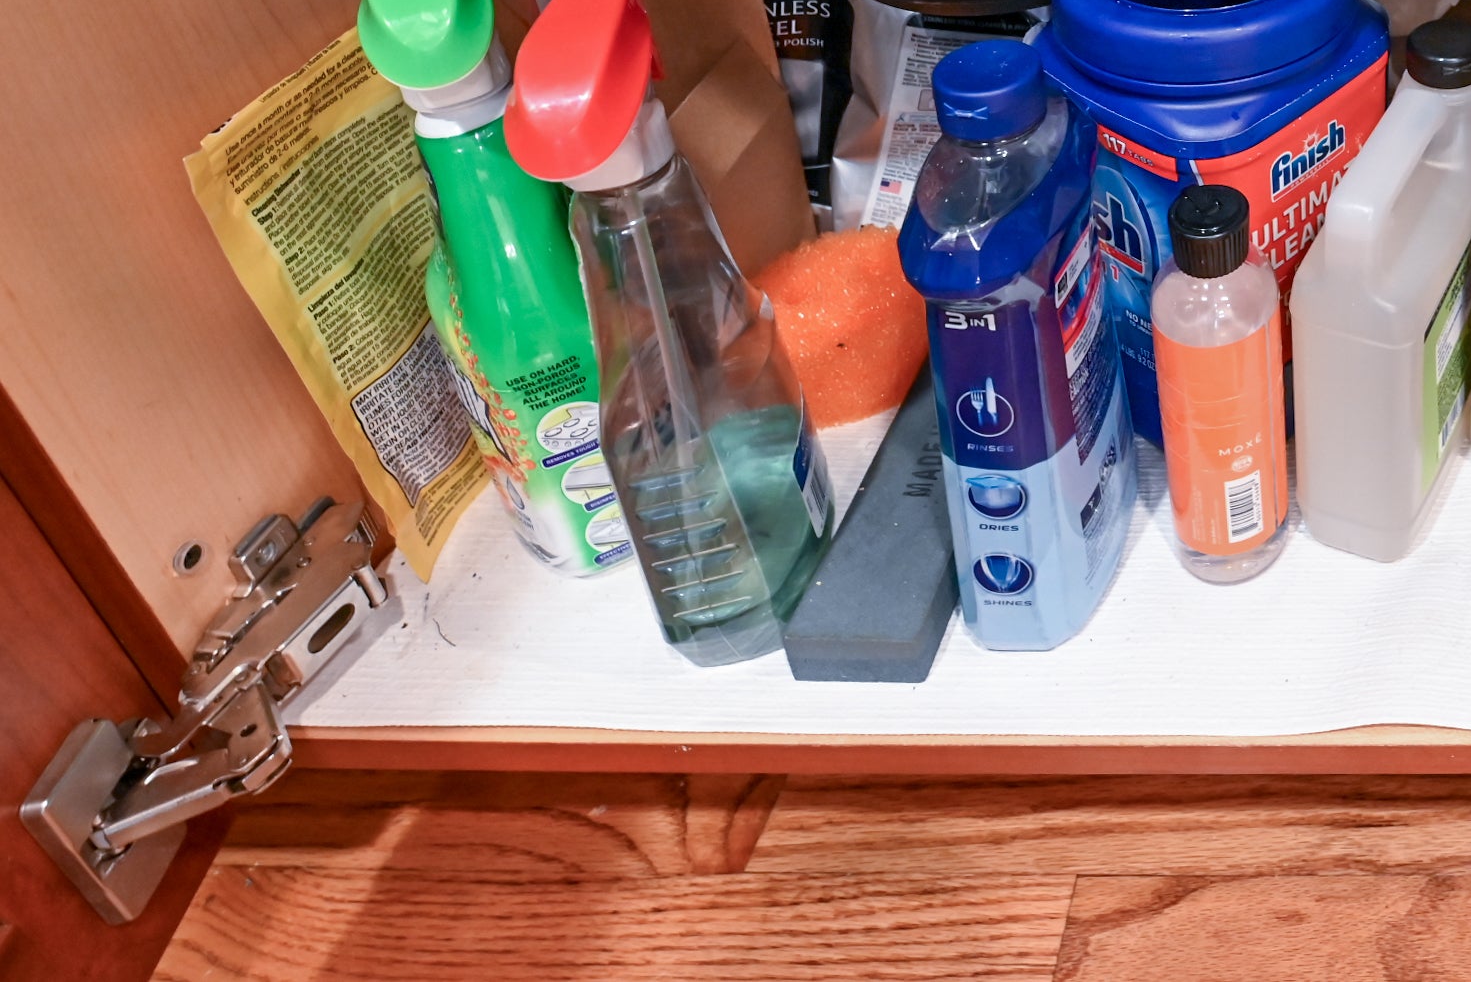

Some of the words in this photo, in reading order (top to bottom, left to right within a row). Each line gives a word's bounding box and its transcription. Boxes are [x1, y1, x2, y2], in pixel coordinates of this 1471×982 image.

[783, 37, 825, 48] POLISH
[224, 141, 241, 155] Use
[239, 127, 257, 144] once
[261, 104, 284, 125] month
[284, 98, 293, 107] or
[292, 92, 302, 101] as
[301, 72, 327, 94] needed
[326, 65, 337, 75] for
[233, 151, 266, 180] triturador
[264, 143, 275, 154] de
[273, 125, 298, 146] basura
[1103, 133, 1126, 155] 117
[1271, 120, 1345, 195] finish
[233, 161, 269, 194] suministro
[268, 154, 278, 164] de
[277, 143, 289, 156] 2-6
[251, 194, 277, 217] Cleaning
[307, 287, 335, 313] Limpieza
[333, 279, 345, 291] del
[505, 375, 527, 387] USE
[529, 369, 545, 379] ON
[547, 354, 581, 373] HARD,
[512, 361, 581, 393] NON-POROUS
[523, 371, 578, 397] SURFACES
[354, 389, 374, 407] MAY
[373, 364, 405, 393] IRRITATE
[359, 385, 395, 415] IRRITATE
[364, 398, 391, 423] FUMES
[390, 380, 411, 401] FORM
[409, 362, 425, 382] WHEN
[522, 393, 541, 405] ALL
[543, 376, 587, 398] AROUND
[529, 400, 549, 412] THE
[551, 385, 586, 404] HOME!
[367, 406, 395, 431] OTHER
[371, 419, 393, 438] WITH
[392, 399, 416, 422] LIQUID
[374, 429, 391, 445] GET
[390, 422, 401, 433] IN
[377, 435, 399, 453] SKIN
[397, 426, 410, 438] OR
[381, 449, 394, 460] OF
[393, 428, 420, 451] REACH
[966, 442, 1014, 453] RINSES
[978, 522, 1020, 532] DRIES
[983, 598, 1033, 608] SHINES
